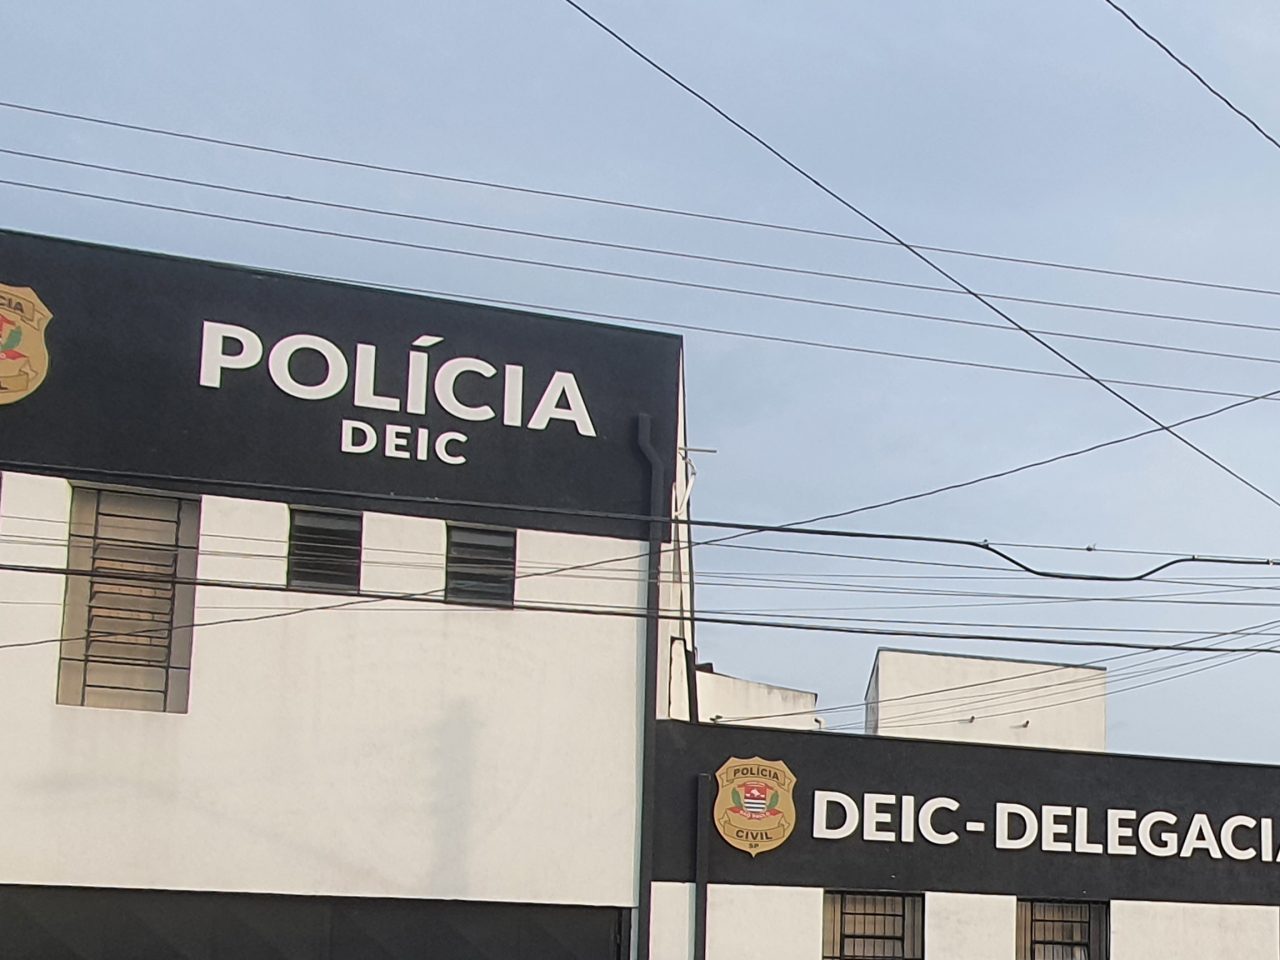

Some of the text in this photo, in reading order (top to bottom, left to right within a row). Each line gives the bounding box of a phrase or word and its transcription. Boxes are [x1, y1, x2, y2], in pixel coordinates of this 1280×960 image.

[199, 320, 597, 437] POLÍCIA
[341, 419, 468, 465] DEIC
[733, 765, 780, 781] POLÍCIA
[735, 829, 773, 841] CIVIL
